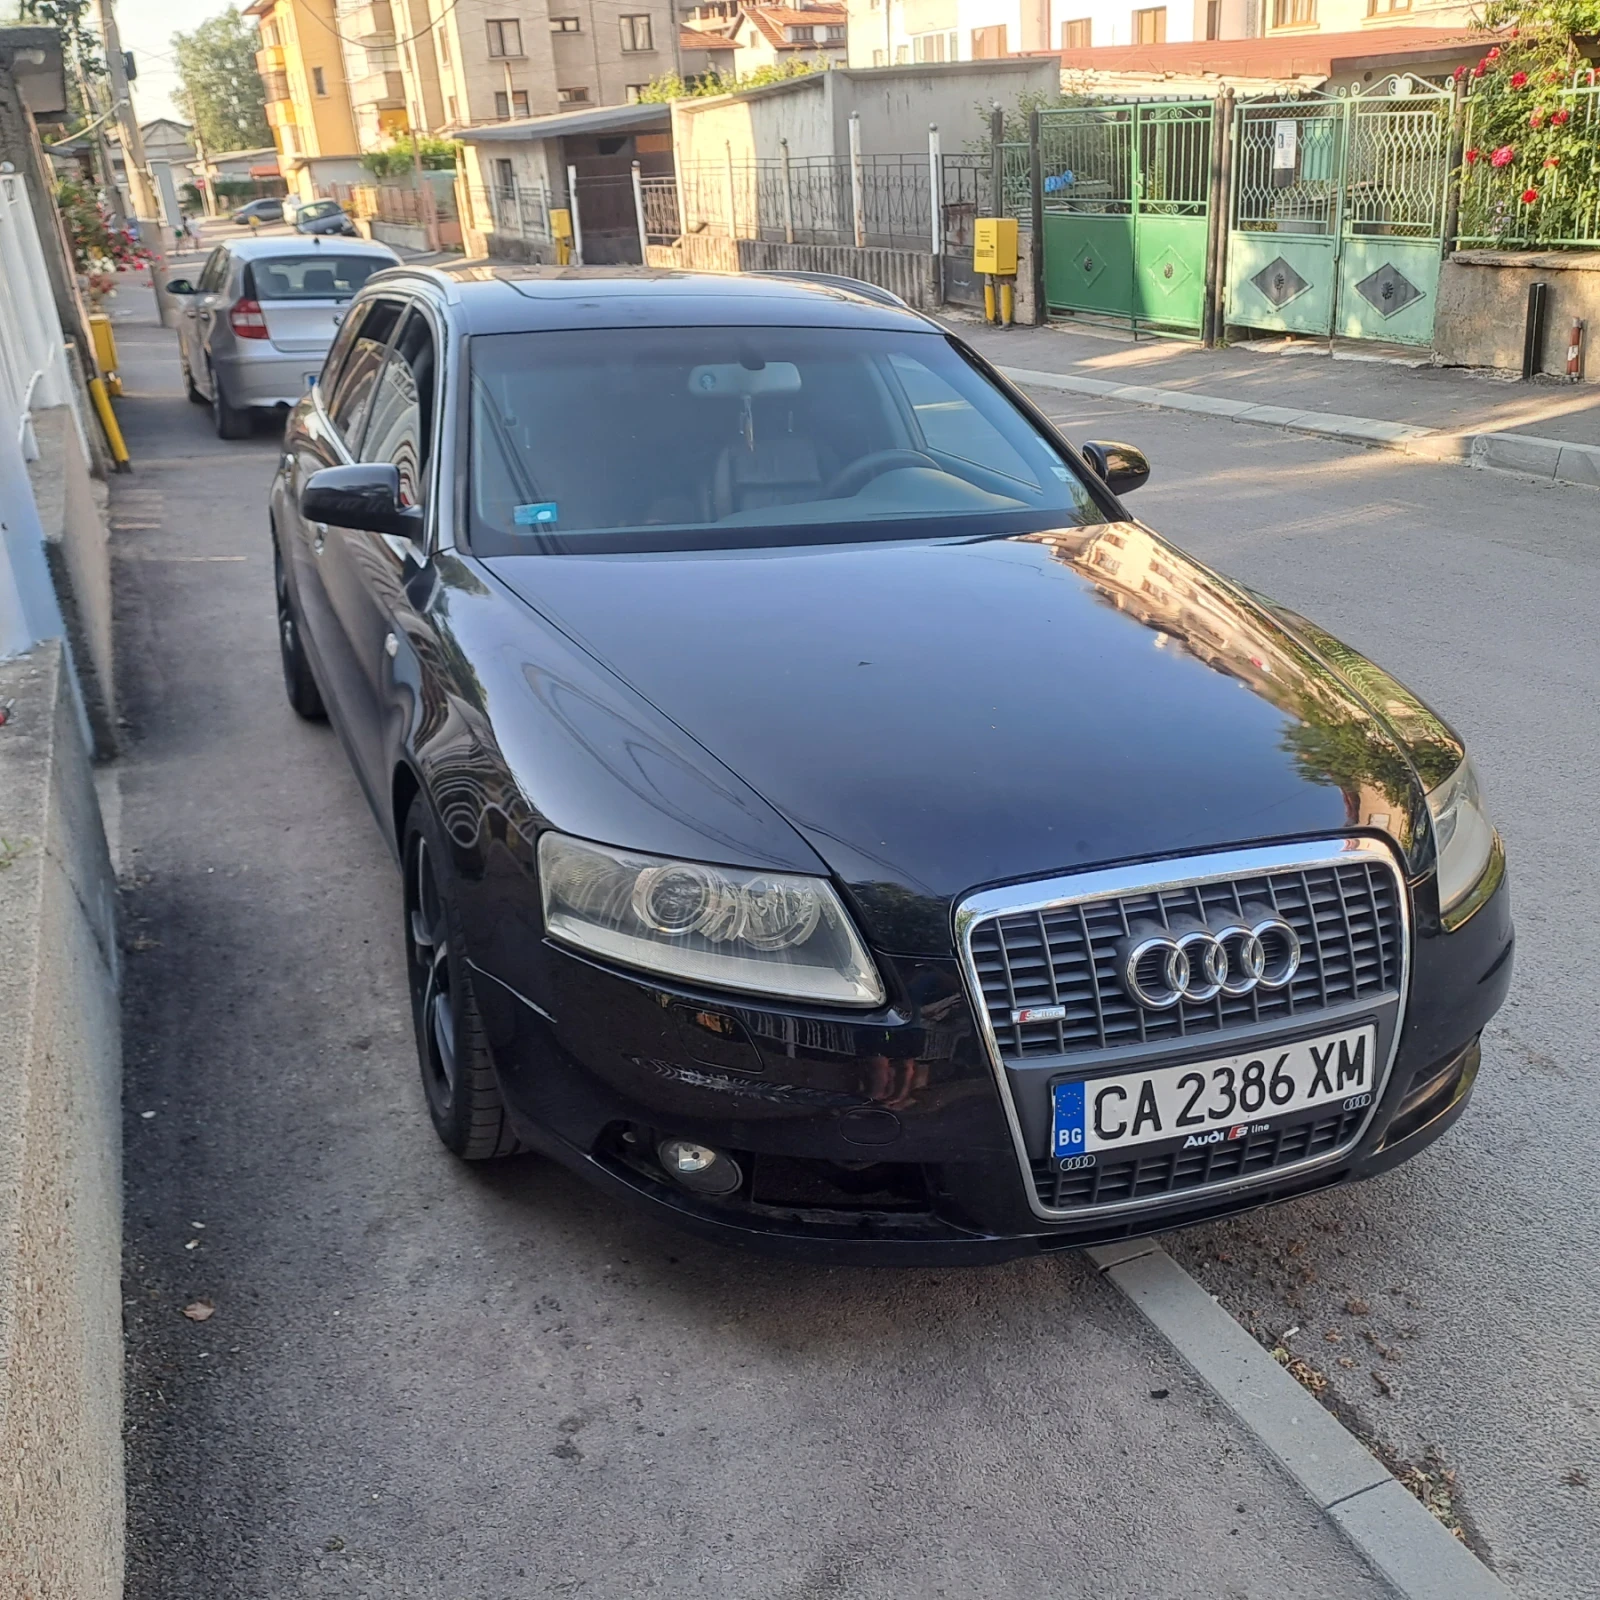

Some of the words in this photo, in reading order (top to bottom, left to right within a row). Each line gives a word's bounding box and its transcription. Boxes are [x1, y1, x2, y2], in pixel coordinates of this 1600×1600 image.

[1094, 1079, 1162, 1141] CA
[1175, 1053, 1295, 1127] 2386
[1307, 1034, 1366, 1098] XM
[1059, 1127, 1083, 1147] BG
[1183, 1130, 1225, 1149] Audi
[1231, 1125, 1249, 1139] S
[1251, 1123, 1270, 1134] line
